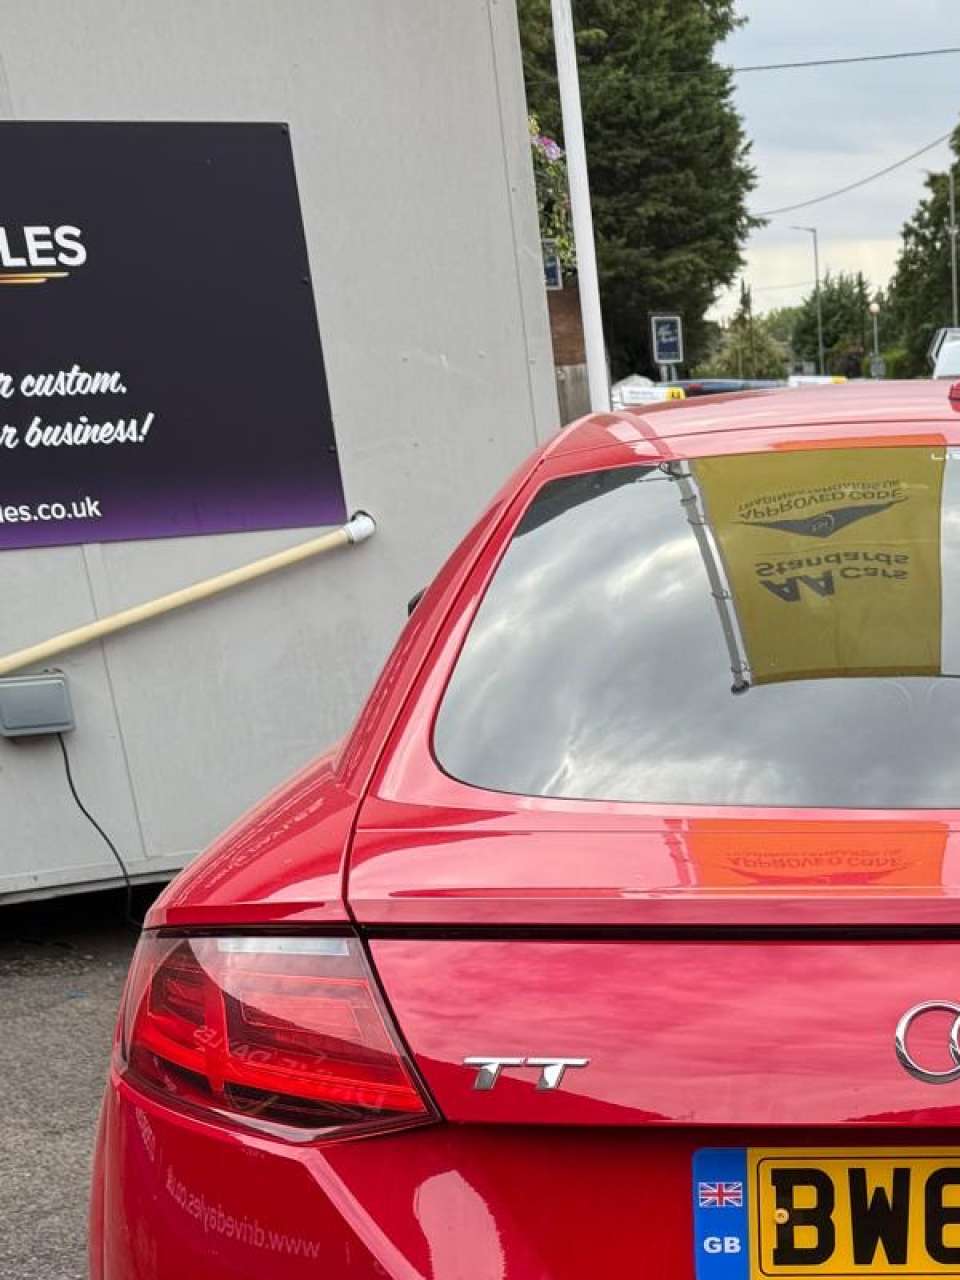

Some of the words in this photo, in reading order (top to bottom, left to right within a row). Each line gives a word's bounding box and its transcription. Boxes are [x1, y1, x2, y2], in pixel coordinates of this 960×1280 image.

[20, 364, 128, 398] custom.
[25, 412, 155, 448] business!
[462, 1055, 591, 1091] TT
[703, 1236, 742, 1255] GB
